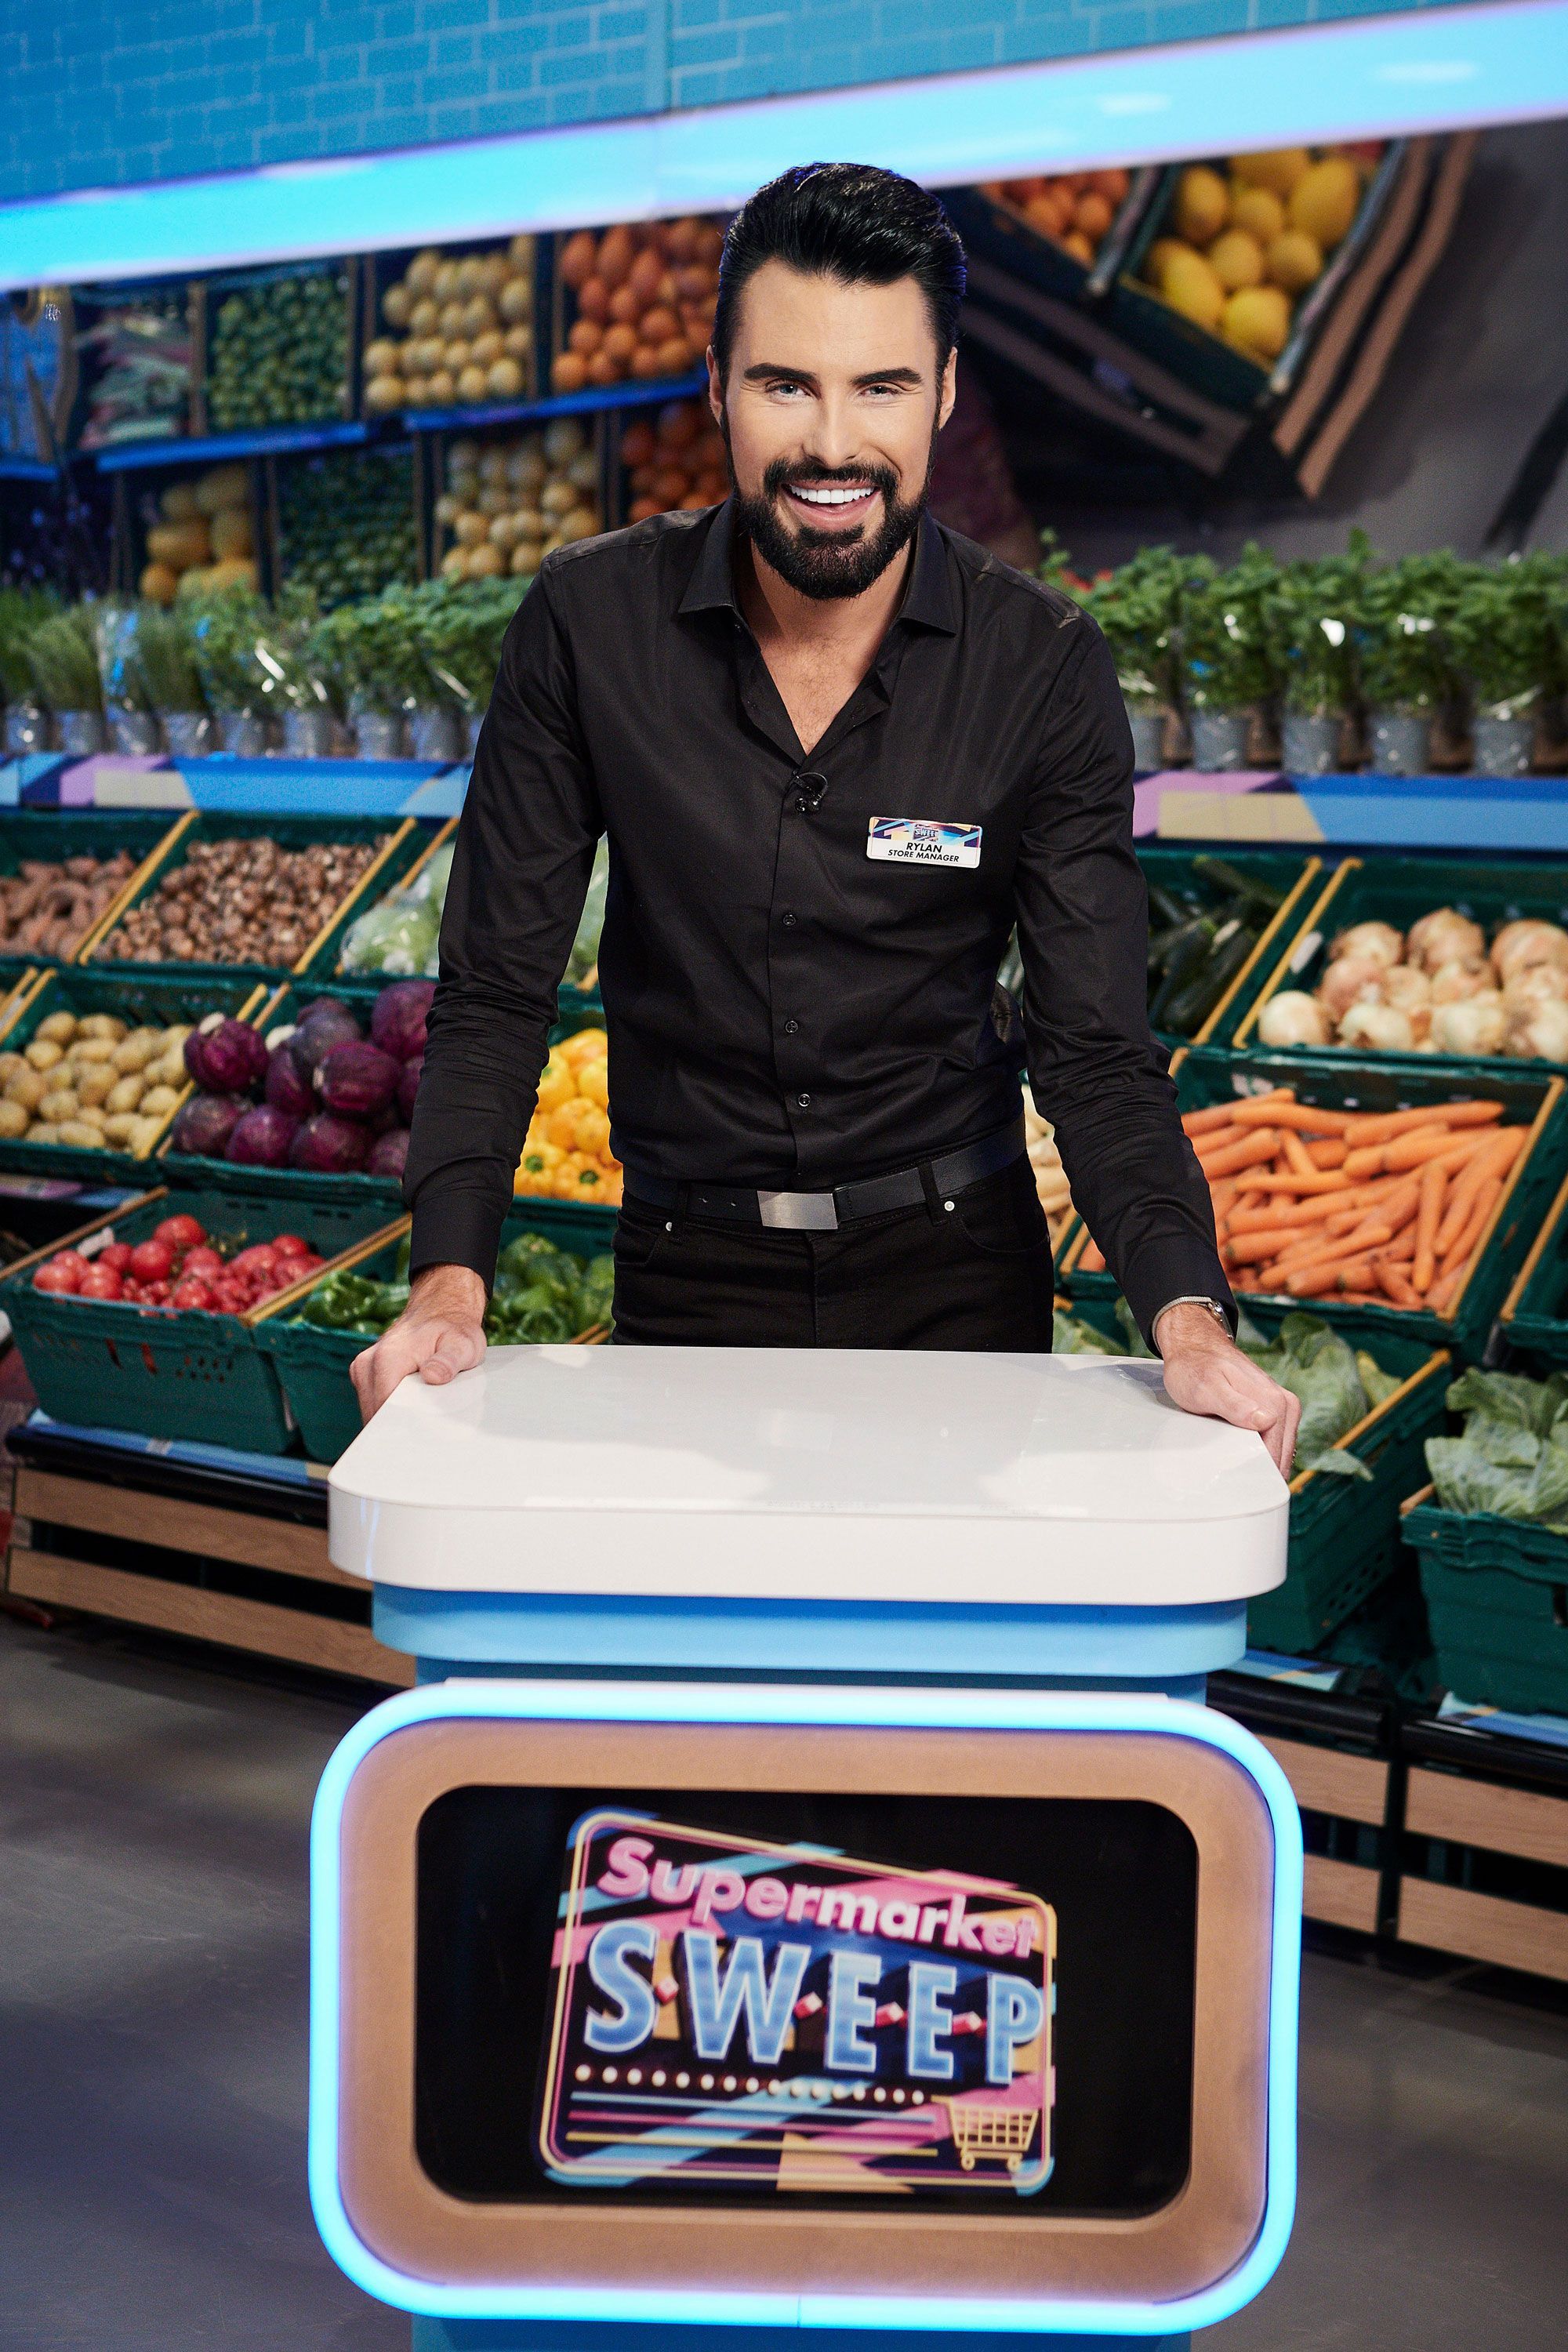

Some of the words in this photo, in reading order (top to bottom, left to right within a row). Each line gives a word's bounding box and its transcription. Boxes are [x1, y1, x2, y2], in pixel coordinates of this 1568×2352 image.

[887, 849, 914, 858] STORE
[916, 853, 960, 862] MANAGER
[906, 842, 942, 853] RYLAN
[598, 1836, 1040, 1958] Supermarket
[583, 1918, 1045, 2085] SWEEP
